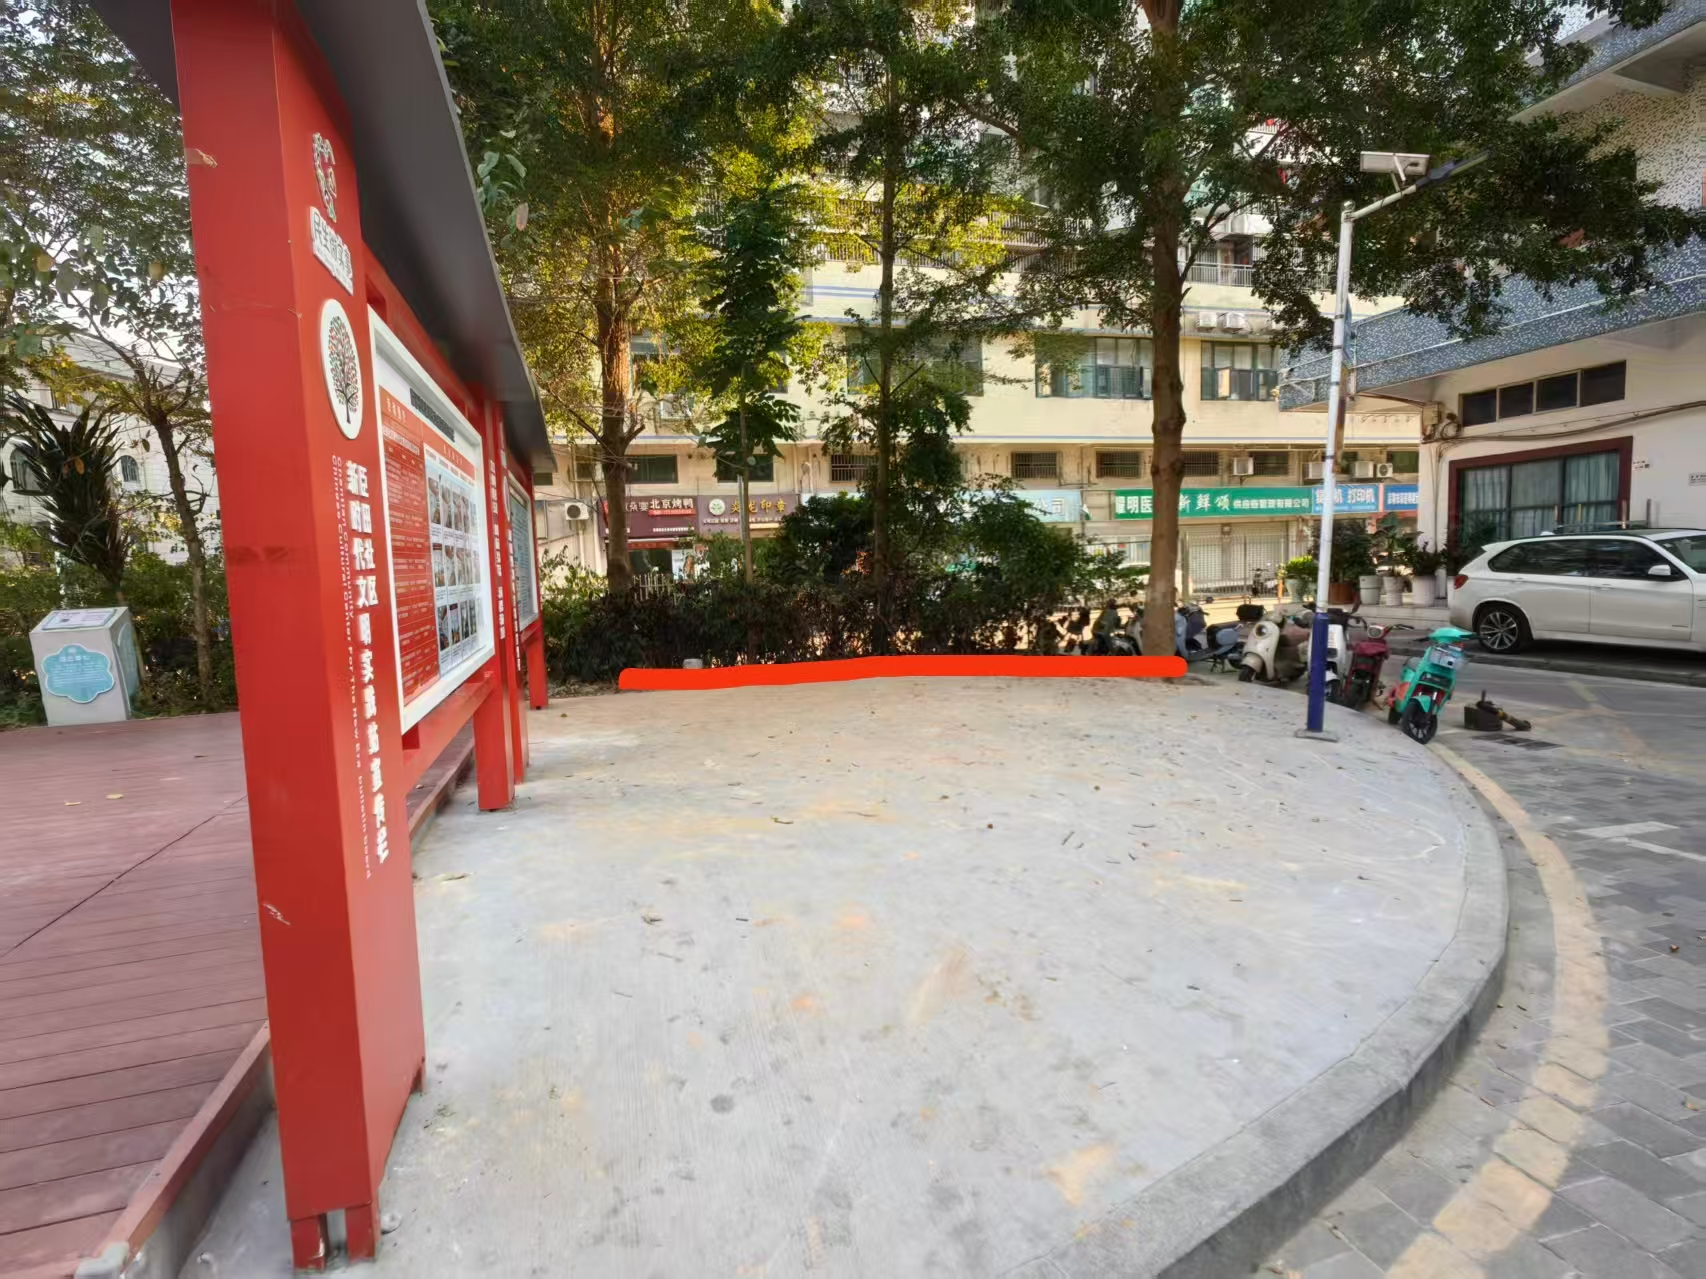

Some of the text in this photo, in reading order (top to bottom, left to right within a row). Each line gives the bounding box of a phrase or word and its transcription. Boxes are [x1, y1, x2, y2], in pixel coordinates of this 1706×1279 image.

[1315, 489, 1344, 505] 复机
[1347, 487, 1376, 504] 打印机
[650, 498, 694, 510] 北京烤鸭
